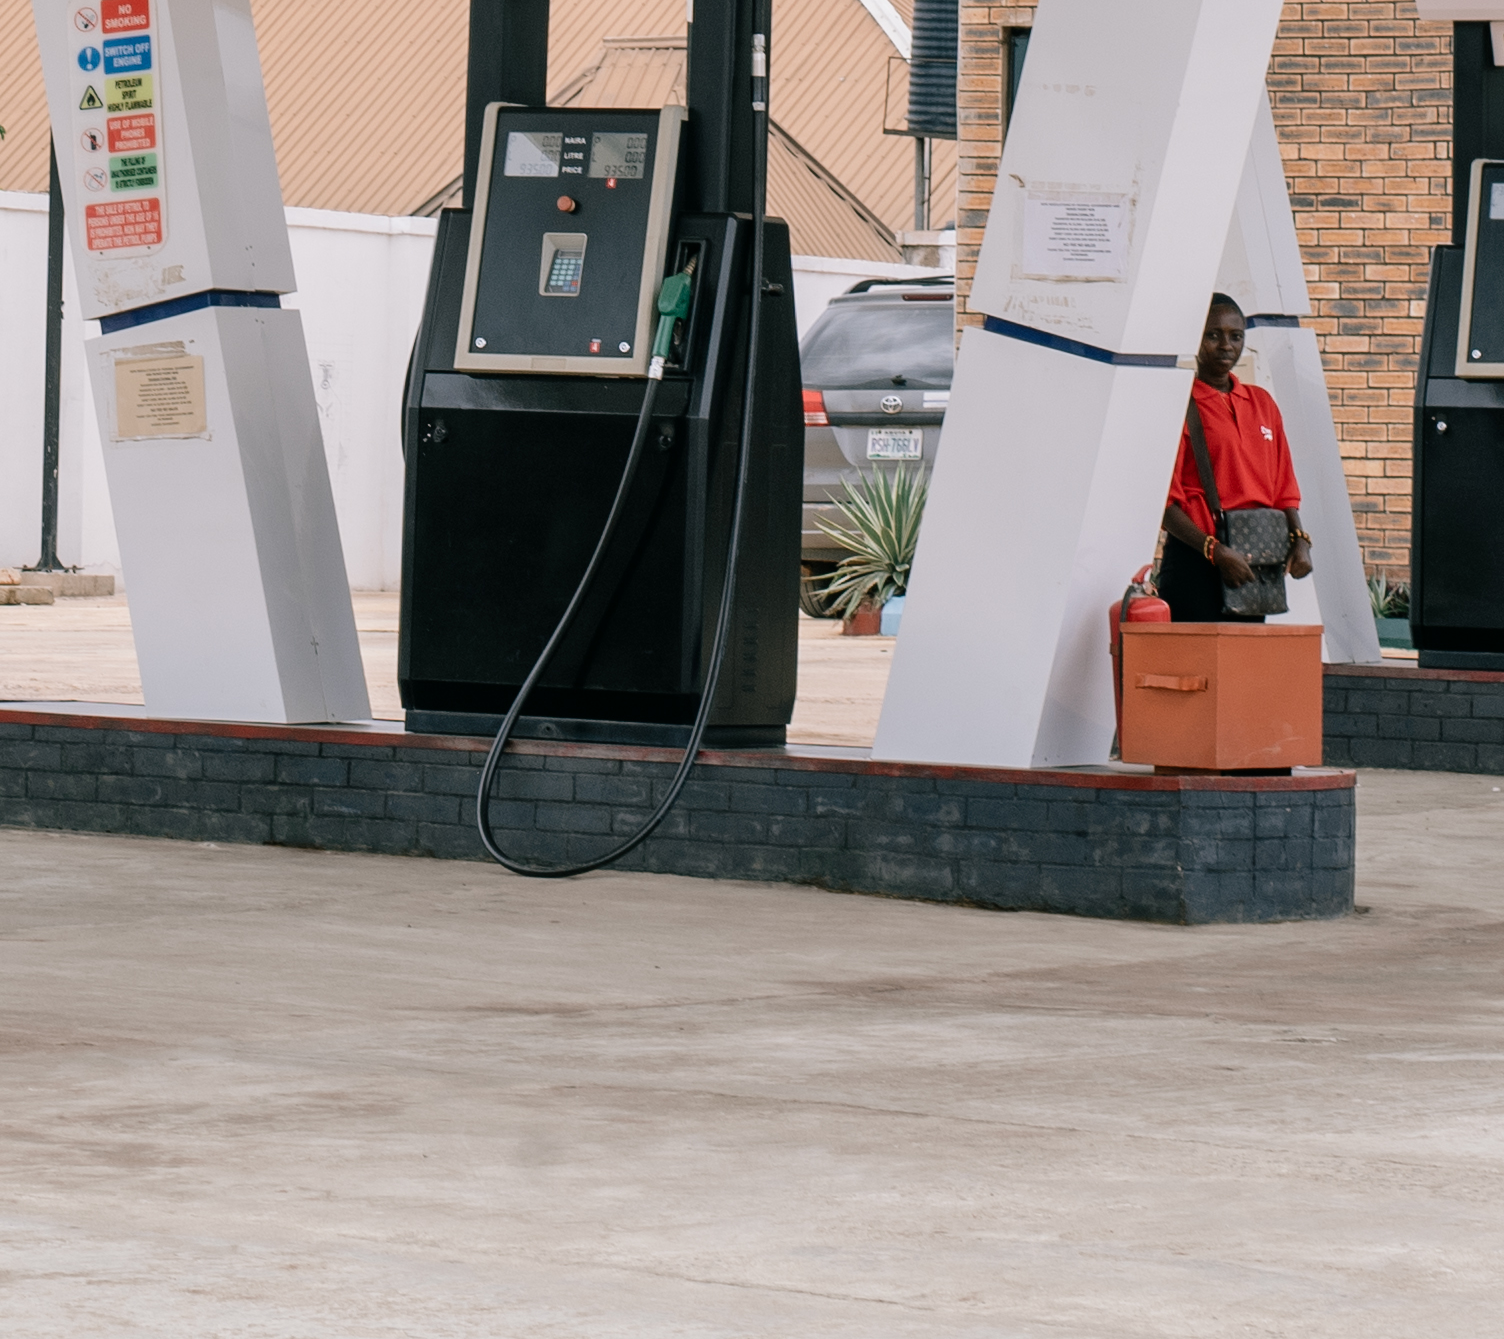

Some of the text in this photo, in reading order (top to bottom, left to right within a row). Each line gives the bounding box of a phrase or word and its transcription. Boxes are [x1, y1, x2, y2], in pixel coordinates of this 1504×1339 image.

[118, 4, 132, 14] NO
[104, 15, 147, 29] SMOKING
[104, 42, 150, 57] SWITCH OFF
[113, 55, 143, 68] ENGINE
[115, 78, 143, 89] PETROLEUM
[564, 136, 587, 145] NAIRA
[563, 152, 584, 160] LITRE
[561, 166, 583, 174] PRICE
